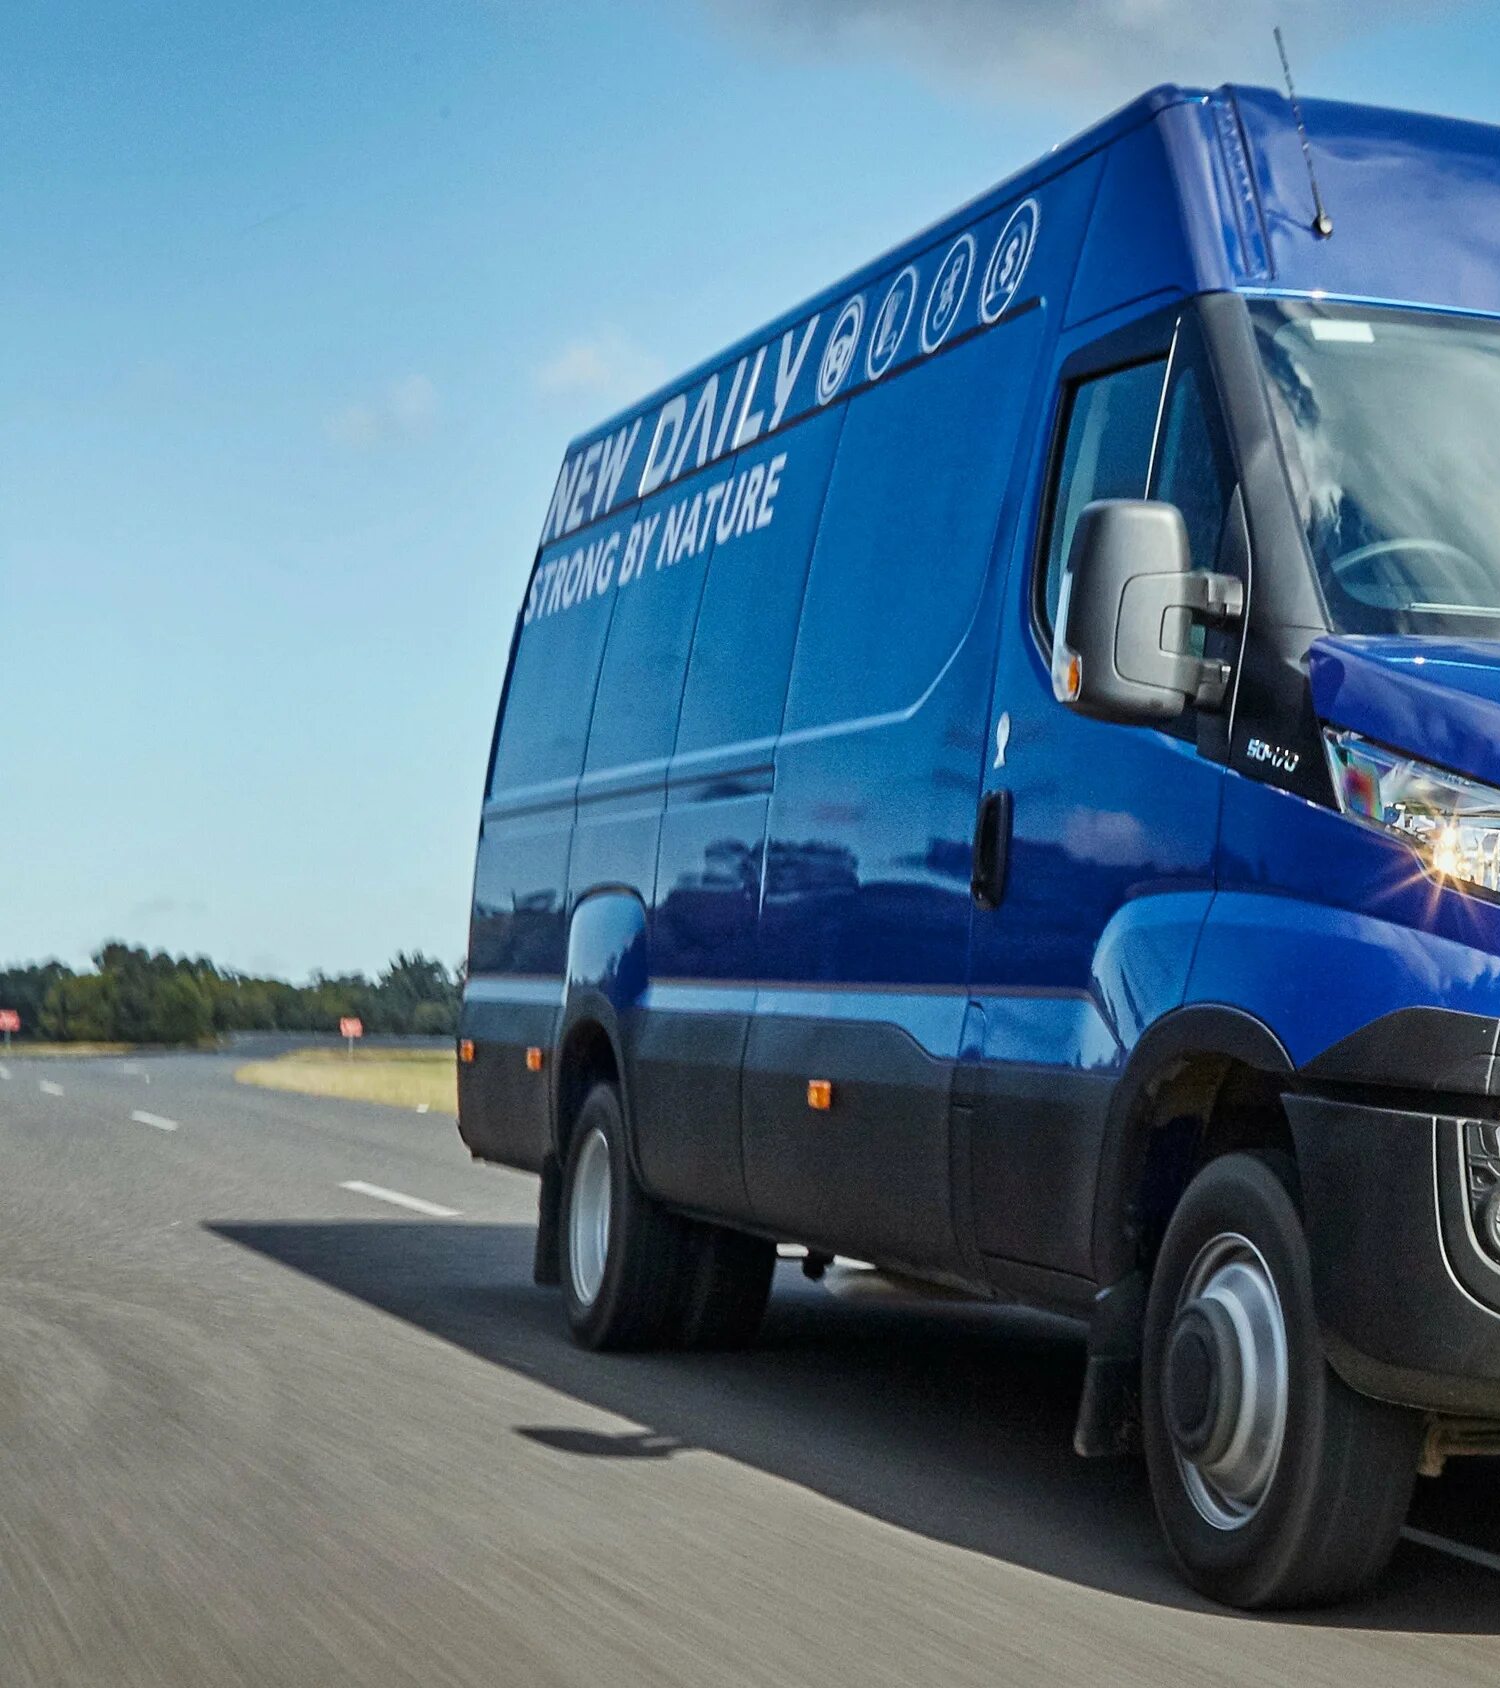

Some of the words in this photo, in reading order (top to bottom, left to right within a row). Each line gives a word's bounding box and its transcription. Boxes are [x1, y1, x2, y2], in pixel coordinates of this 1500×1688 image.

[541, 416, 643, 546] NEW
[638, 313, 820, 498] DAILY
[524, 531, 620, 626] STRONG
[618, 511, 661, 586] BY
[656, 452, 787, 571] NATURE
